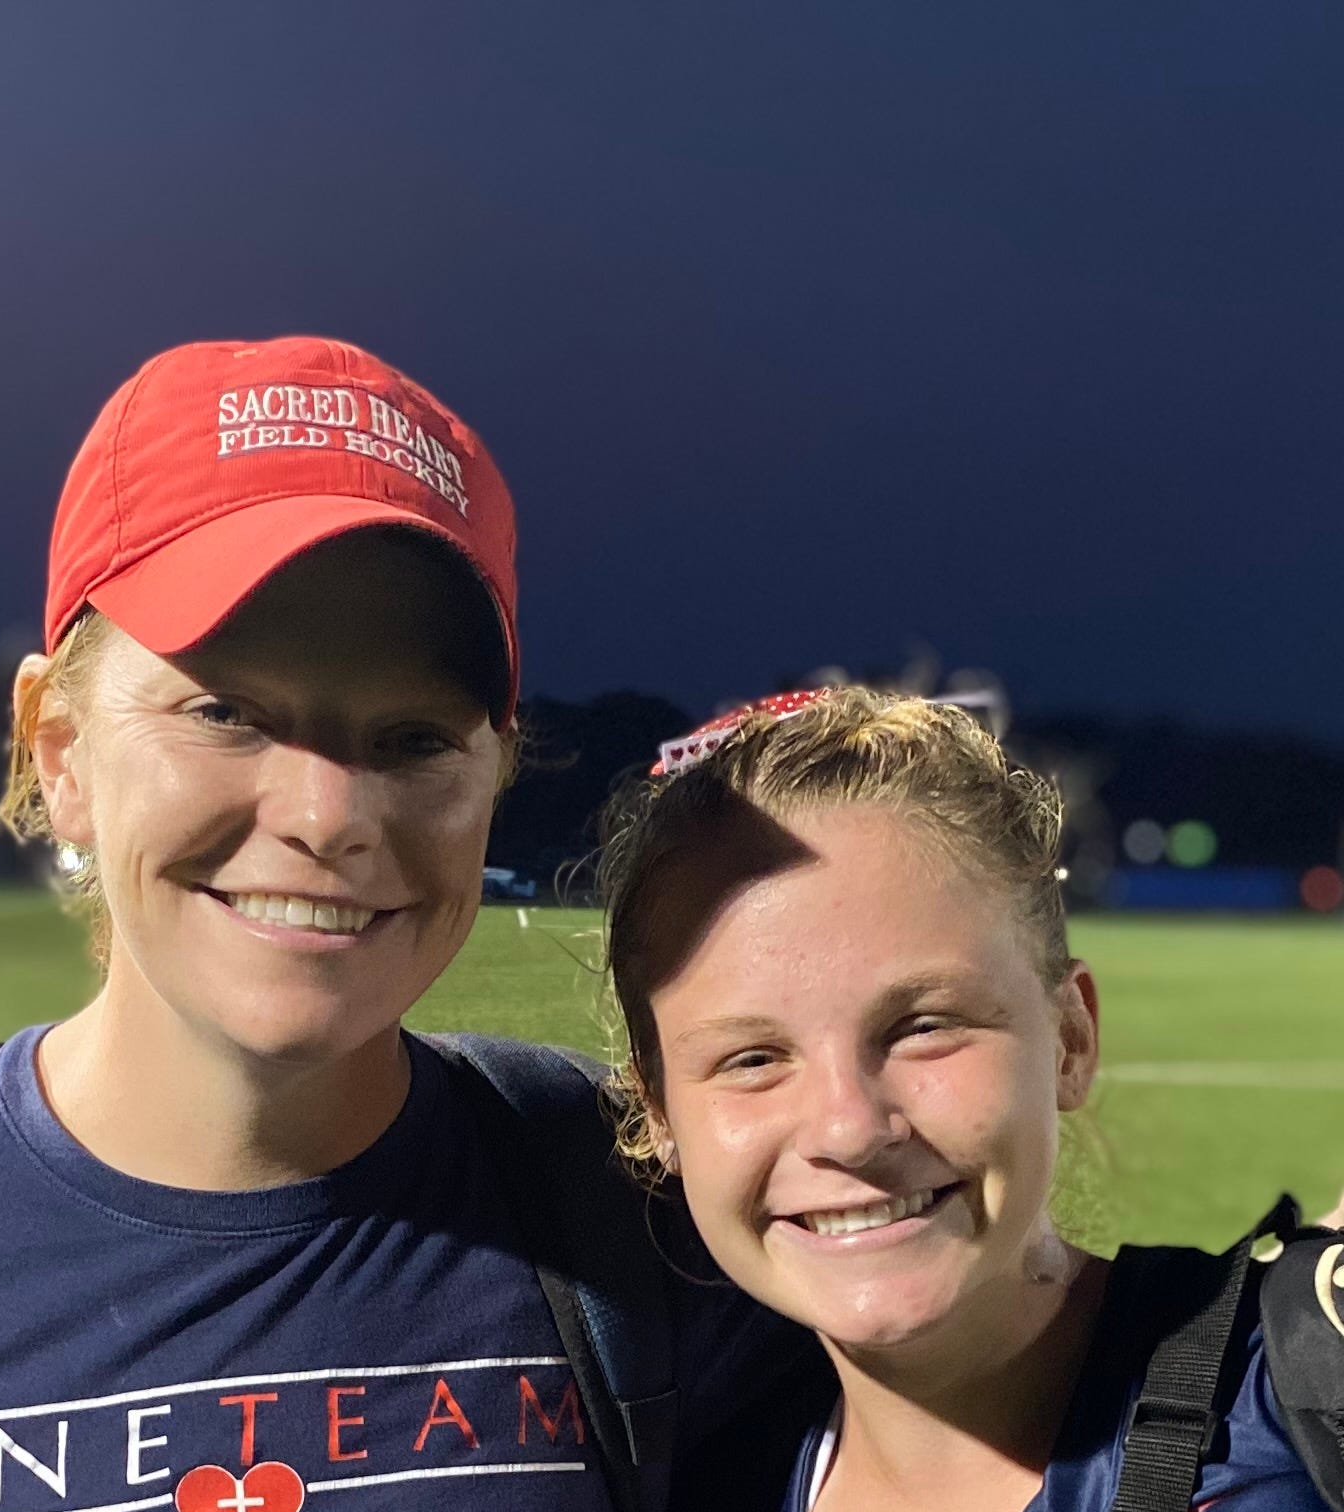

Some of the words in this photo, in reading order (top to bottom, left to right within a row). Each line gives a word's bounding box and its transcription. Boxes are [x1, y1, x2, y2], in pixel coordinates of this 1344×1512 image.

[217, 424, 329, 456] FIELD
[345, 431, 470, 518] HOCKEY
[218, 385, 359, 427] SACRED
[368, 394, 466, 491] HEART
[218, 1375, 585, 1468] TEAM
